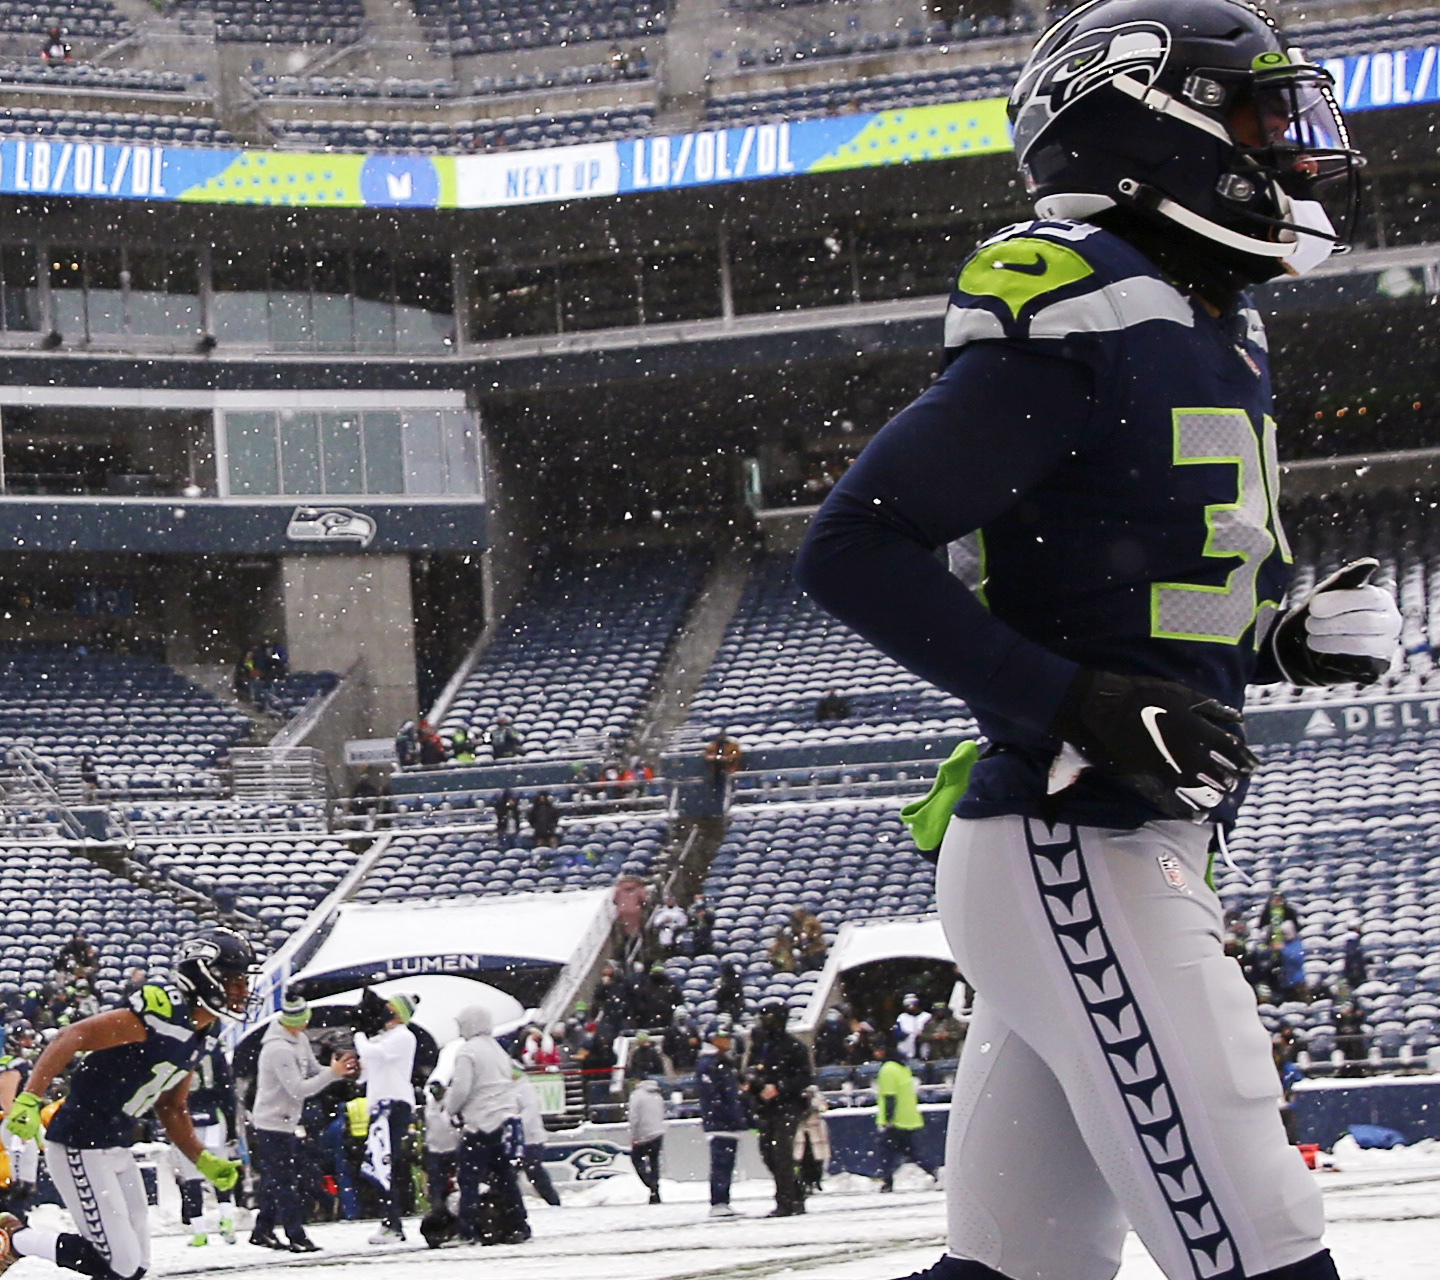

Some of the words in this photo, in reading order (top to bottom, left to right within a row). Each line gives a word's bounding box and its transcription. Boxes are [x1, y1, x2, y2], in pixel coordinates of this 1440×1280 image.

[16, 140, 168, 196] LB/OL/DL
[505, 163, 566, 200] NEXT
[572, 160, 601, 192] UP
[631, 124, 795, 188] LB/OL/DL
[386, 954, 480, 974] LUMEN
